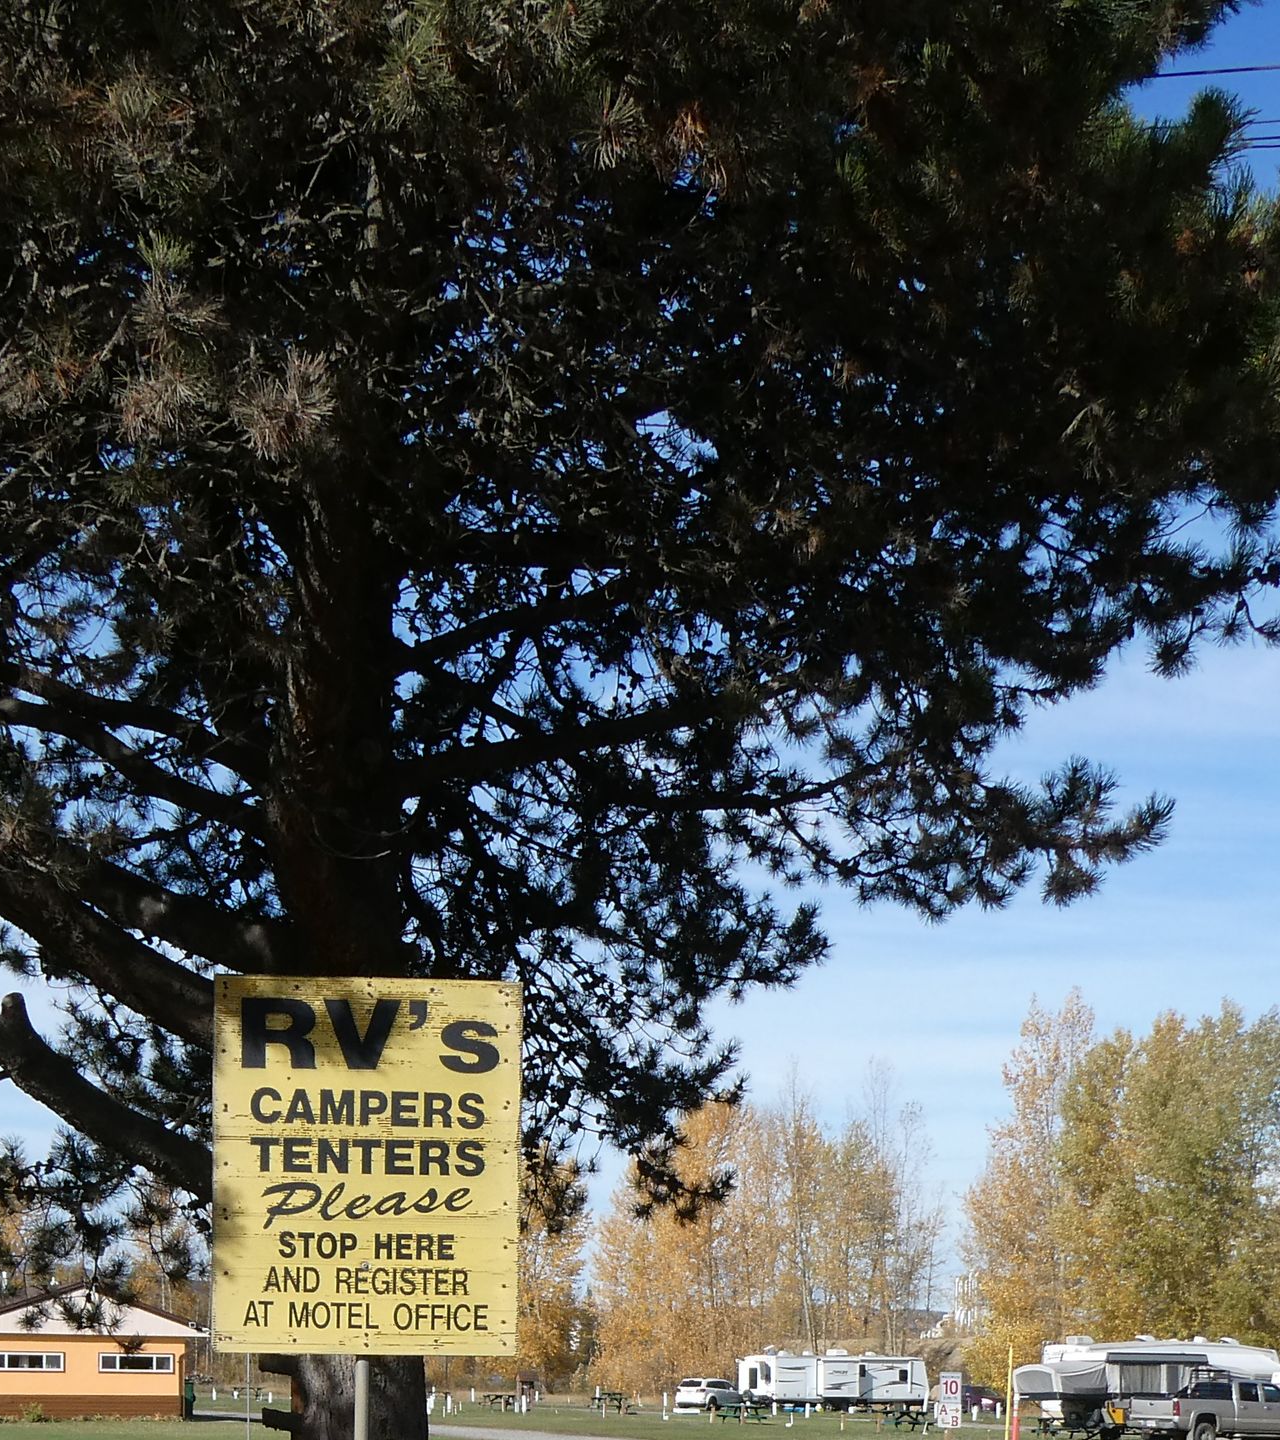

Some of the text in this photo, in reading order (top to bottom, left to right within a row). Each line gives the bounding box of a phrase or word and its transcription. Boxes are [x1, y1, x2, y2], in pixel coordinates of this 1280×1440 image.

[241, 997, 500, 1074] RV's
[250, 1087, 485, 1129] CAMPERS
[250, 1137, 485, 1177] TENTERS
[261, 1181, 473, 1230] Please
[278, 1231, 455, 1261] STOP HERE
[263, 1266, 469, 1296] AND REGISTER
[243, 1301, 489, 1331] AT MOTEL OFFICE
[942, 1380, 958, 1395] 10
[940, 1404, 948, 1415] A
[951, 1416, 958, 1426] B
